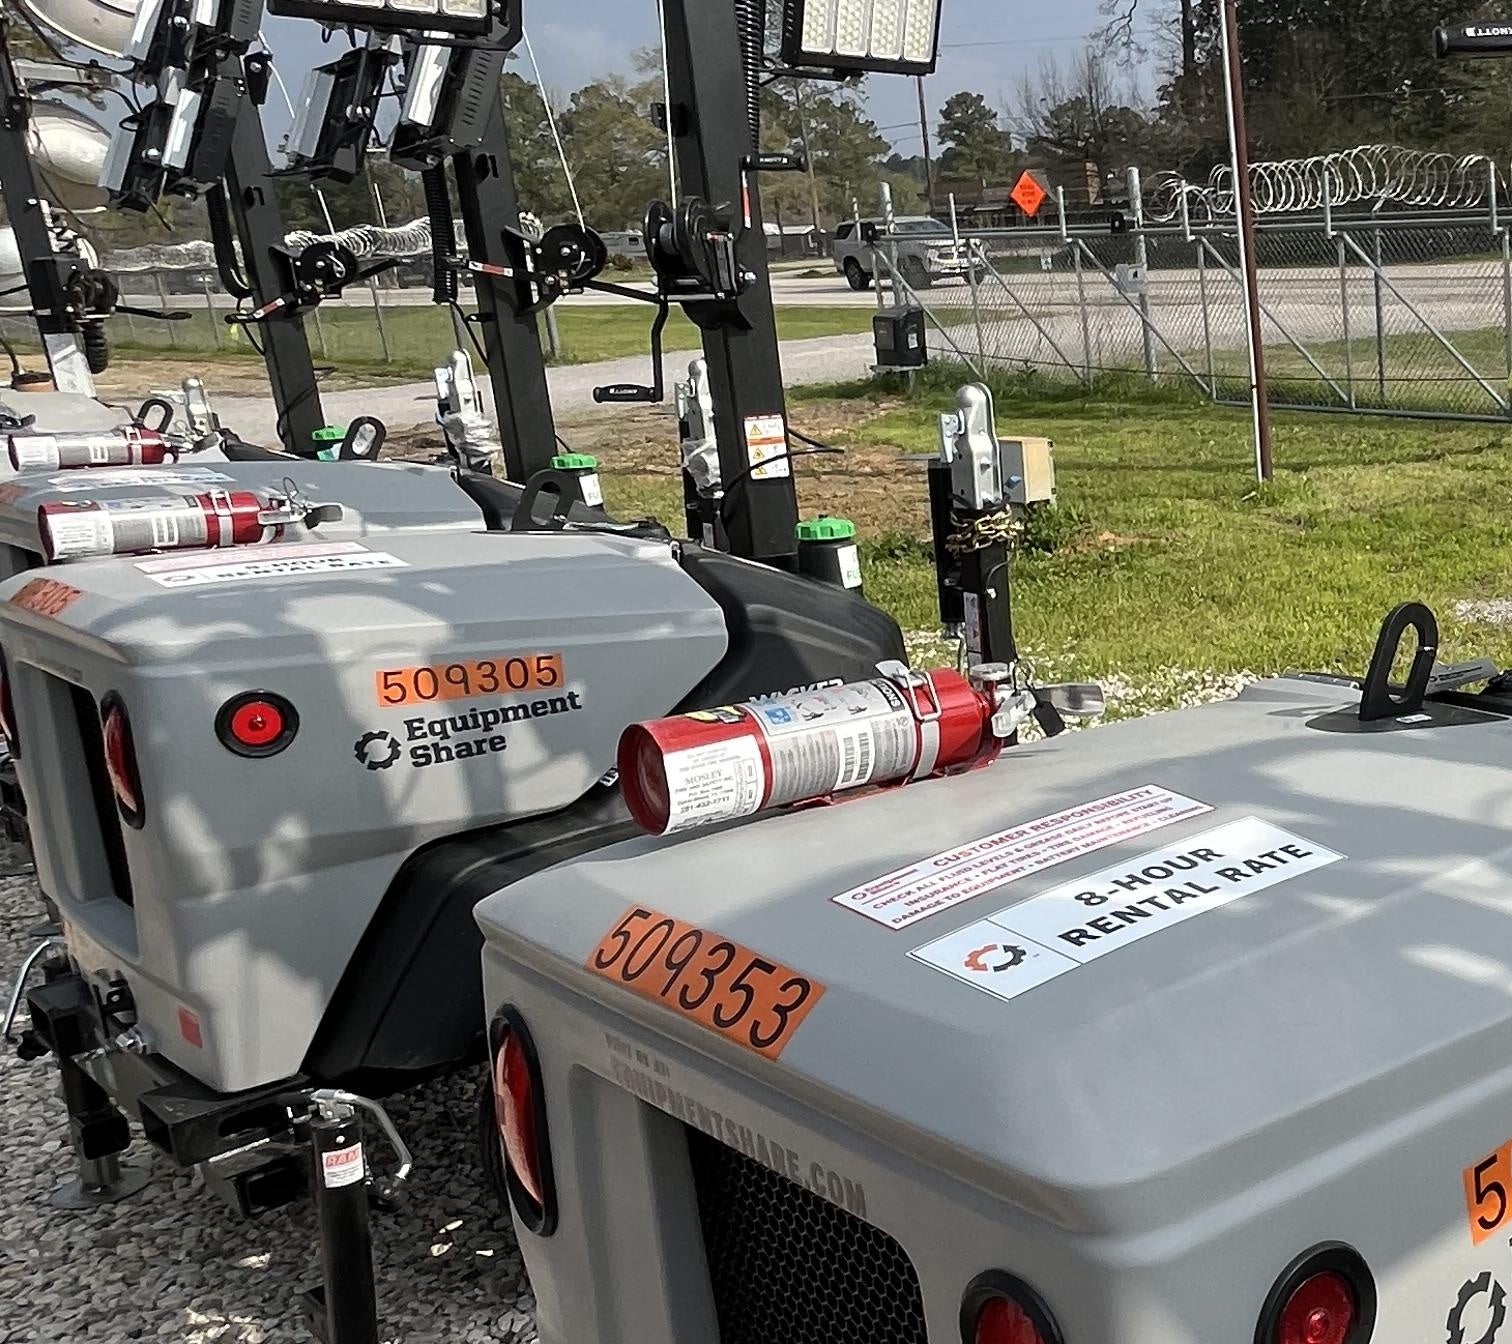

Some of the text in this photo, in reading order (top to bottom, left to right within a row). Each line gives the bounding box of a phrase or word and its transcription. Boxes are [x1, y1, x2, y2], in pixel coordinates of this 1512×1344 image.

[382, 655, 558, 704] 509305
[403, 690, 583, 742] Equipment
[409, 734, 507, 768] Share
[933, 789, 1153, 867] CUSTOMER RESPONSIBILITY
[873, 890, 916, 909] CHECK
[916, 881, 937, 892] ALL
[938, 866, 973, 881] FLUID
[972, 851, 1014, 869] LEVELS
[1024, 833, 1063, 849] GREASE
[1064, 822, 1092, 835] DAILY
[892, 899, 945, 924] DAMAGE
[944, 892, 961, 902] TO
[961, 866, 1027, 895] EQUIPMENT
[1034, 846, 1081, 865] BATTERY
[904, 876, 973, 907] INSURANCE
[981, 862, 1008, 876] FLAT
[1008, 851, 1041, 864] TIRES
[1047, 839, 1073, 851] TIRE
[1057, 844, 1314, 947] RENTAL RATE
[1073, 848, 1227, 907] 8-HOUR
[594, 908, 811, 1048] 509353
